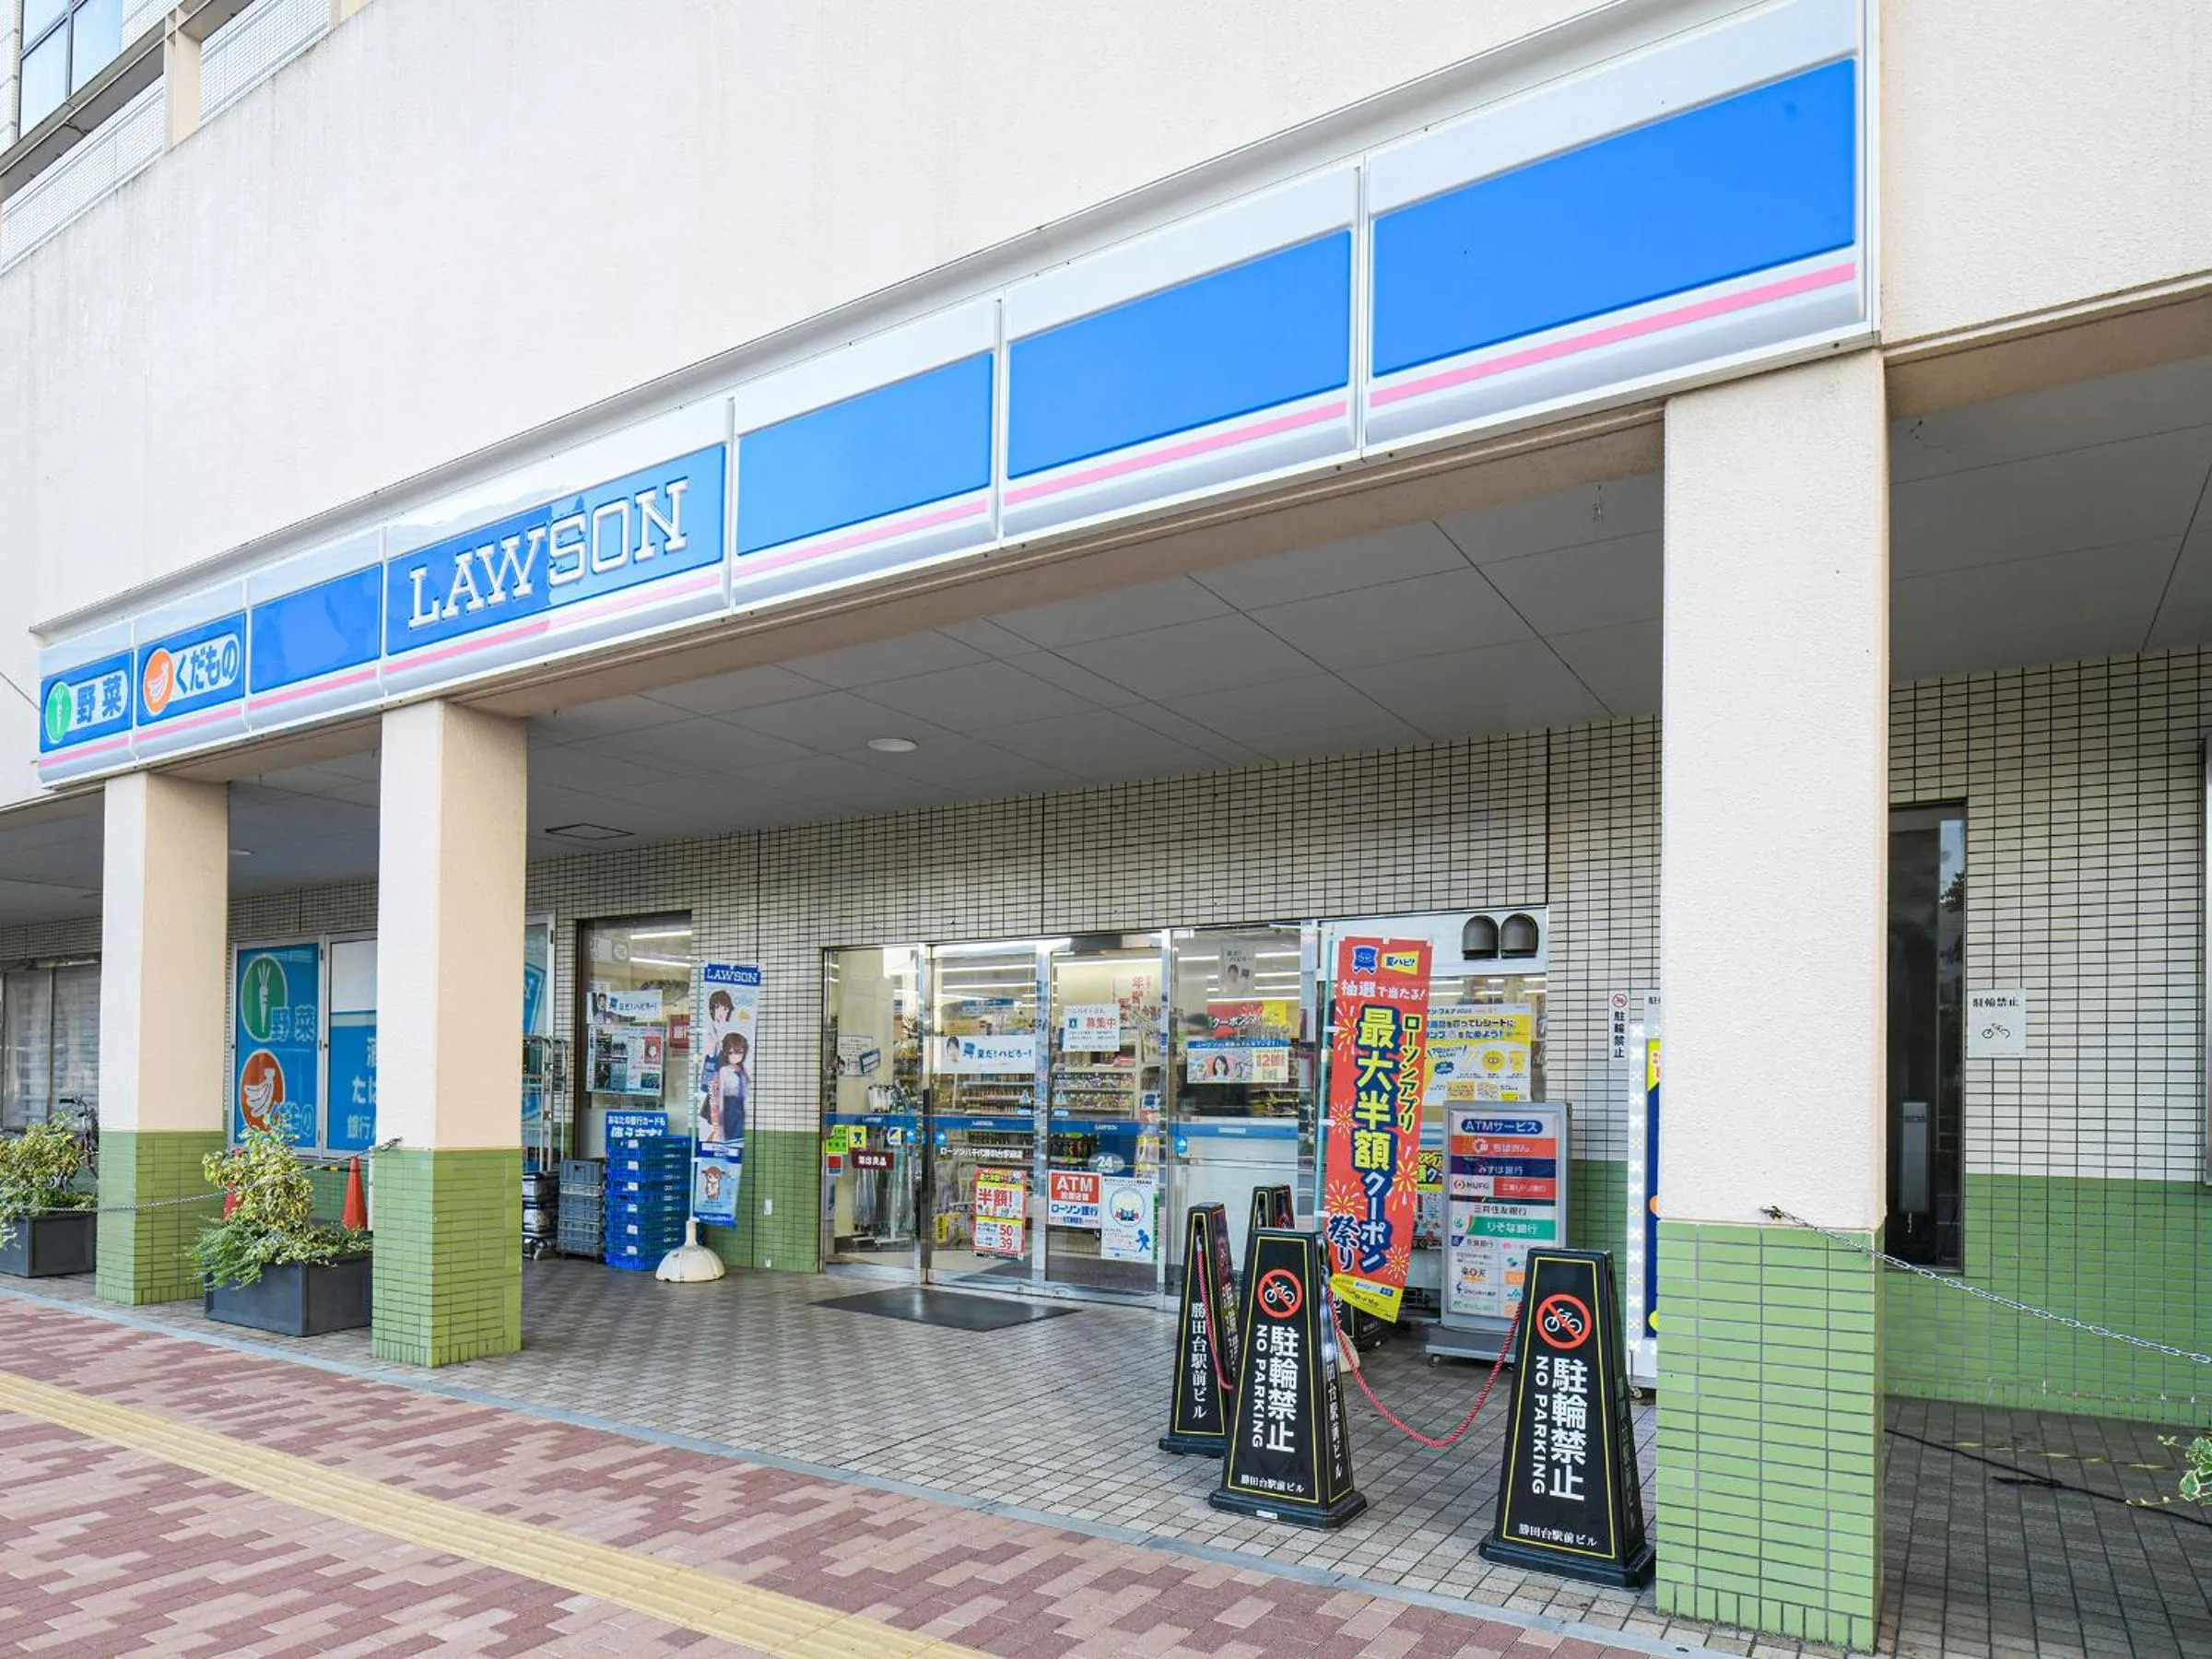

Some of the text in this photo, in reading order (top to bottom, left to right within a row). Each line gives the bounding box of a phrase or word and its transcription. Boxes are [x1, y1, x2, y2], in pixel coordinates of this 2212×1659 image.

[408, 477, 689, 630] LAWSON
[175, 638, 238, 693] くだもの
[76, 677, 123, 724] 野菜
[706, 969, 759, 983] LAWSON
[1341, 979, 1426, 1001] 抽選で当たる!
[1972, 998, 2019, 1007] 駐輪禁止
[271, 1004, 316, 1042] 野菜
[1614, 1011, 1625, 1058] 駐輪禁止
[1399, 1015, 1422, 1134] ローソンアプリ
[1352, 1006, 1396, 1269] 最大半額クーポン
[1465, 1120, 1538, 1133] ATMサービス
[1097, 1156, 1113, 1169] 24
[978, 1188, 1013, 1207] 半額!
[1056, 1176, 1094, 1193] ATM
[1466, 1181, 1489, 1190] MUFG
[1475, 1204, 1527, 1216] 三井住友銀行
[1487, 1221, 1538, 1235] りそな銀行
[1327, 1214, 1359, 1272] 祭り
[1191, 1302, 1207, 1419] 勝田台駅前ビル
[1252, 1324, 1267, 1448] NO PARKING
[1266, 1325, 1300, 1453] 駐輪禁止
[1532, 1356, 1549, 1494] NO PARKING
[1549, 1358, 1588, 1501] 駐輪禁止
[1241, 1474, 1305, 1494] 勝田台駅前ビル
[1518, 1524, 1598, 1547] 勝田台駅前ビル
